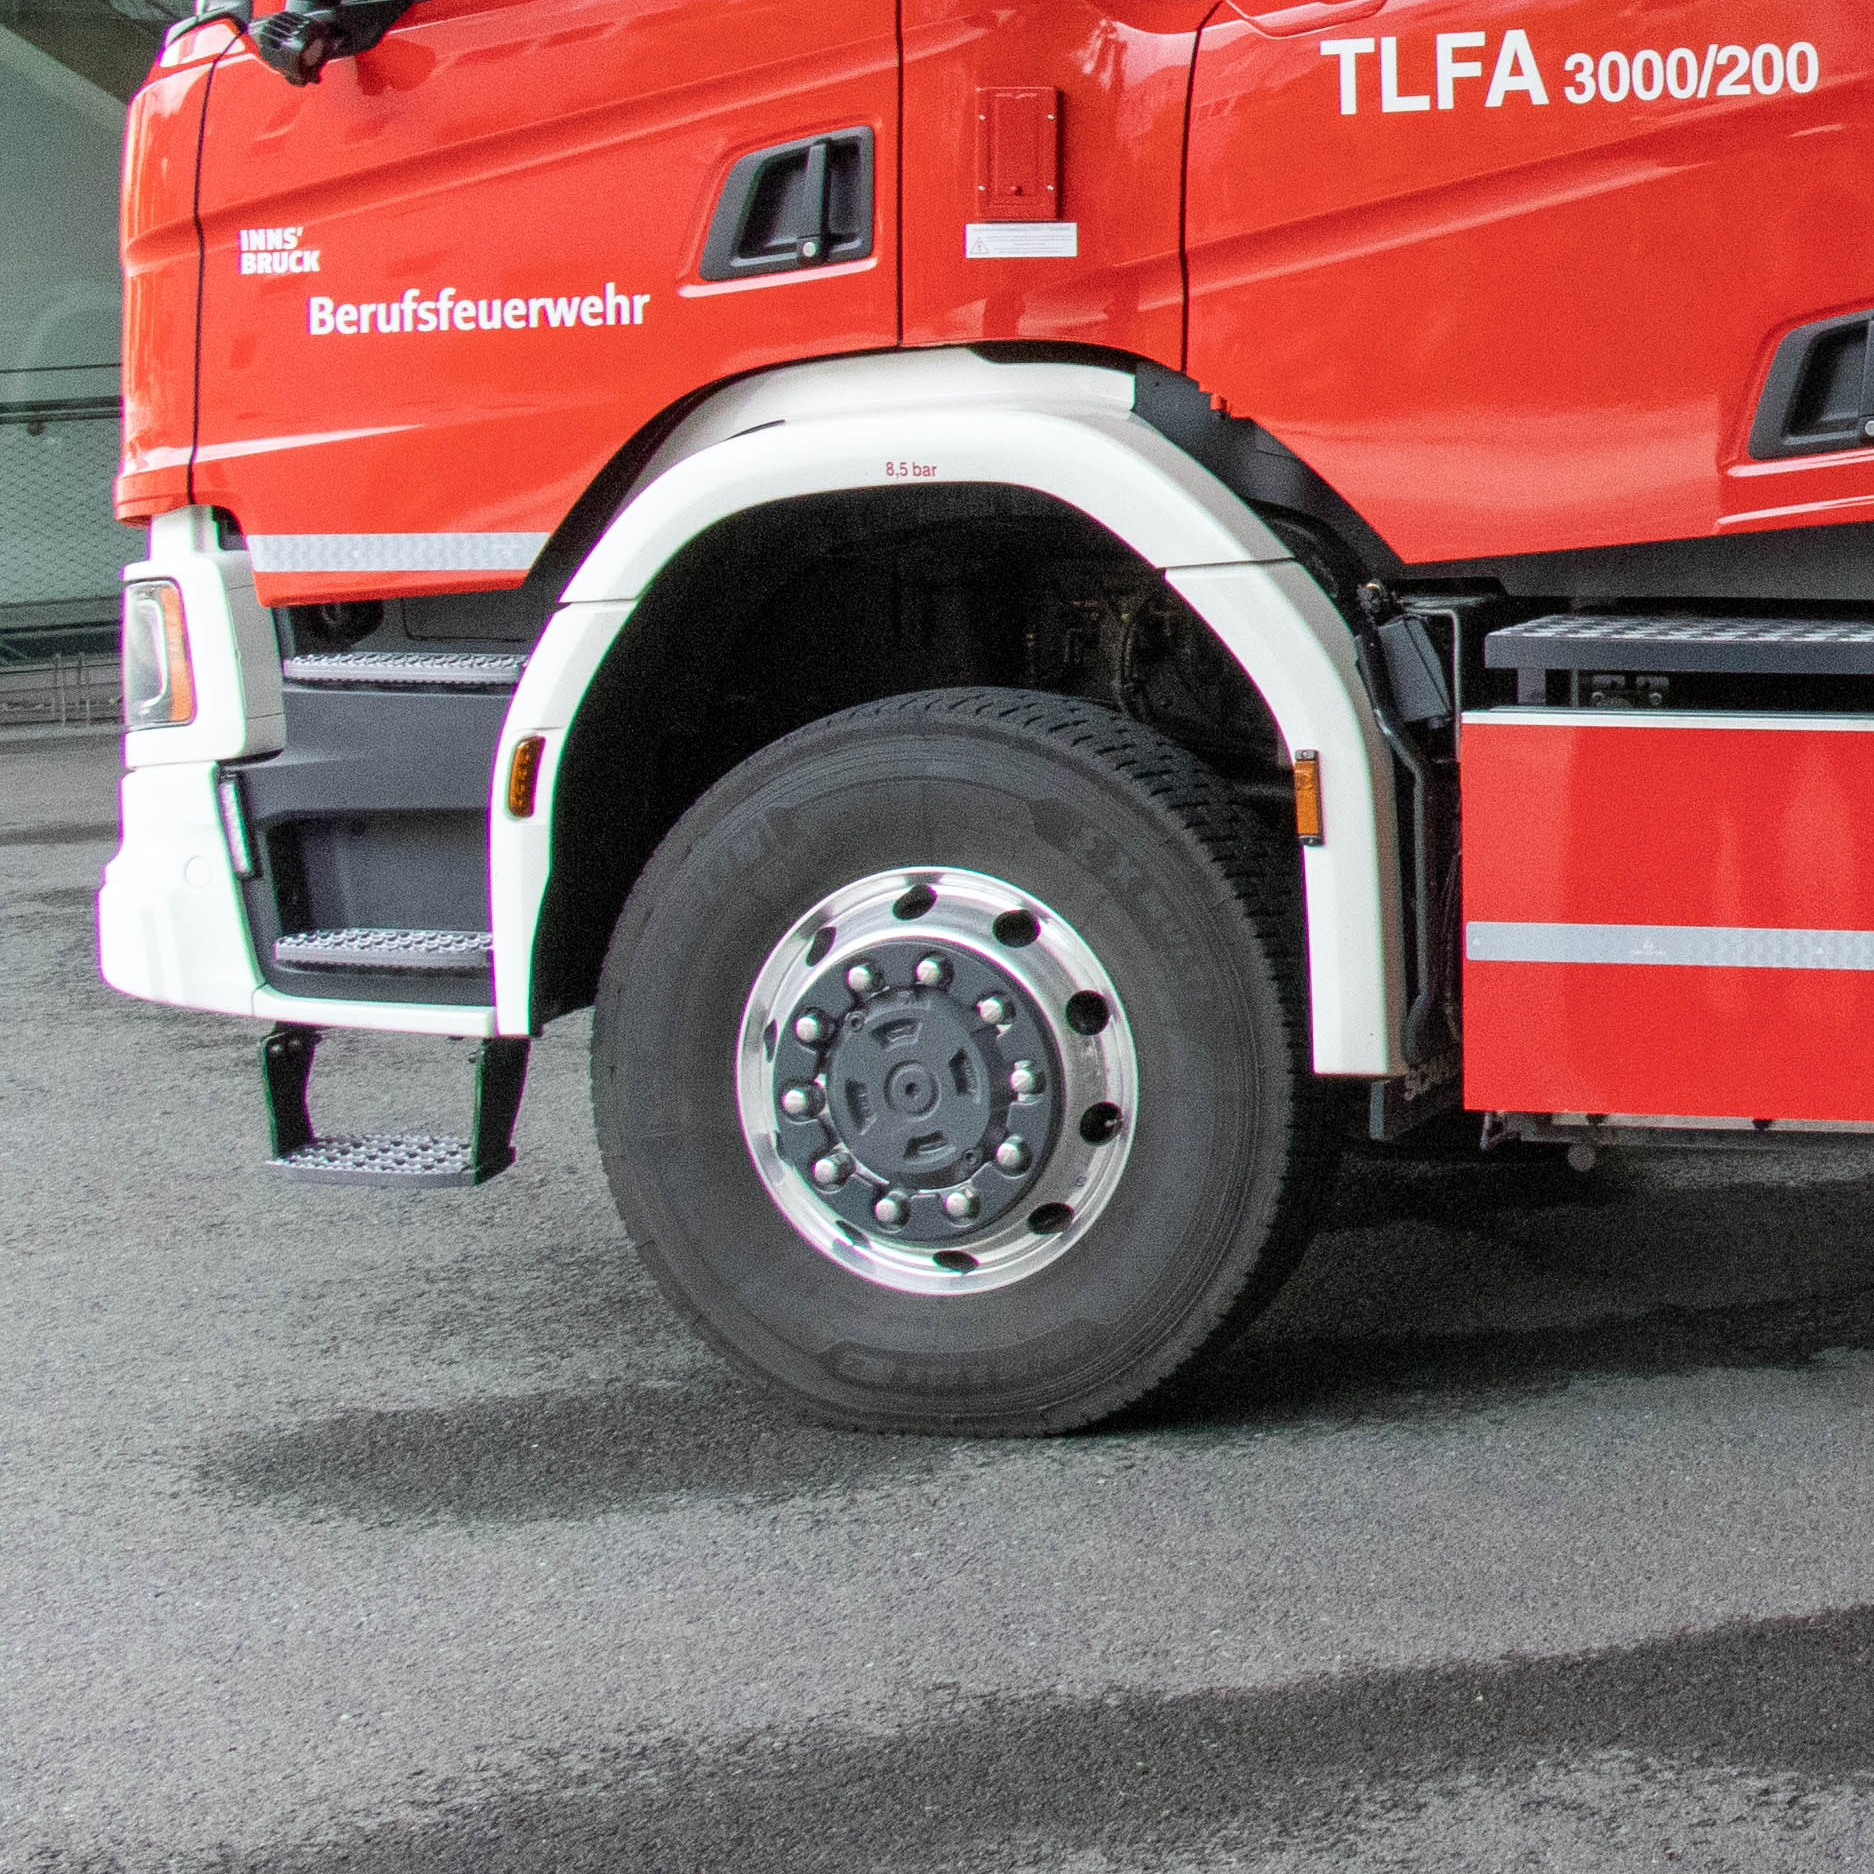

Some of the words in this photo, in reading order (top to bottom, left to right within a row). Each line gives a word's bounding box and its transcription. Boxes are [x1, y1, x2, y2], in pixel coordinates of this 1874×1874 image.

[1320, 29, 1549, 116] TLFA
[1564, 41, 1820, 105] 3000/200
[239, 249, 321, 276] BRUCK
[308, 282, 651, 336] Berufsfeuerwehr
[886, 461, 908, 479] 8,5
[911, 460, 937, 477] bar
